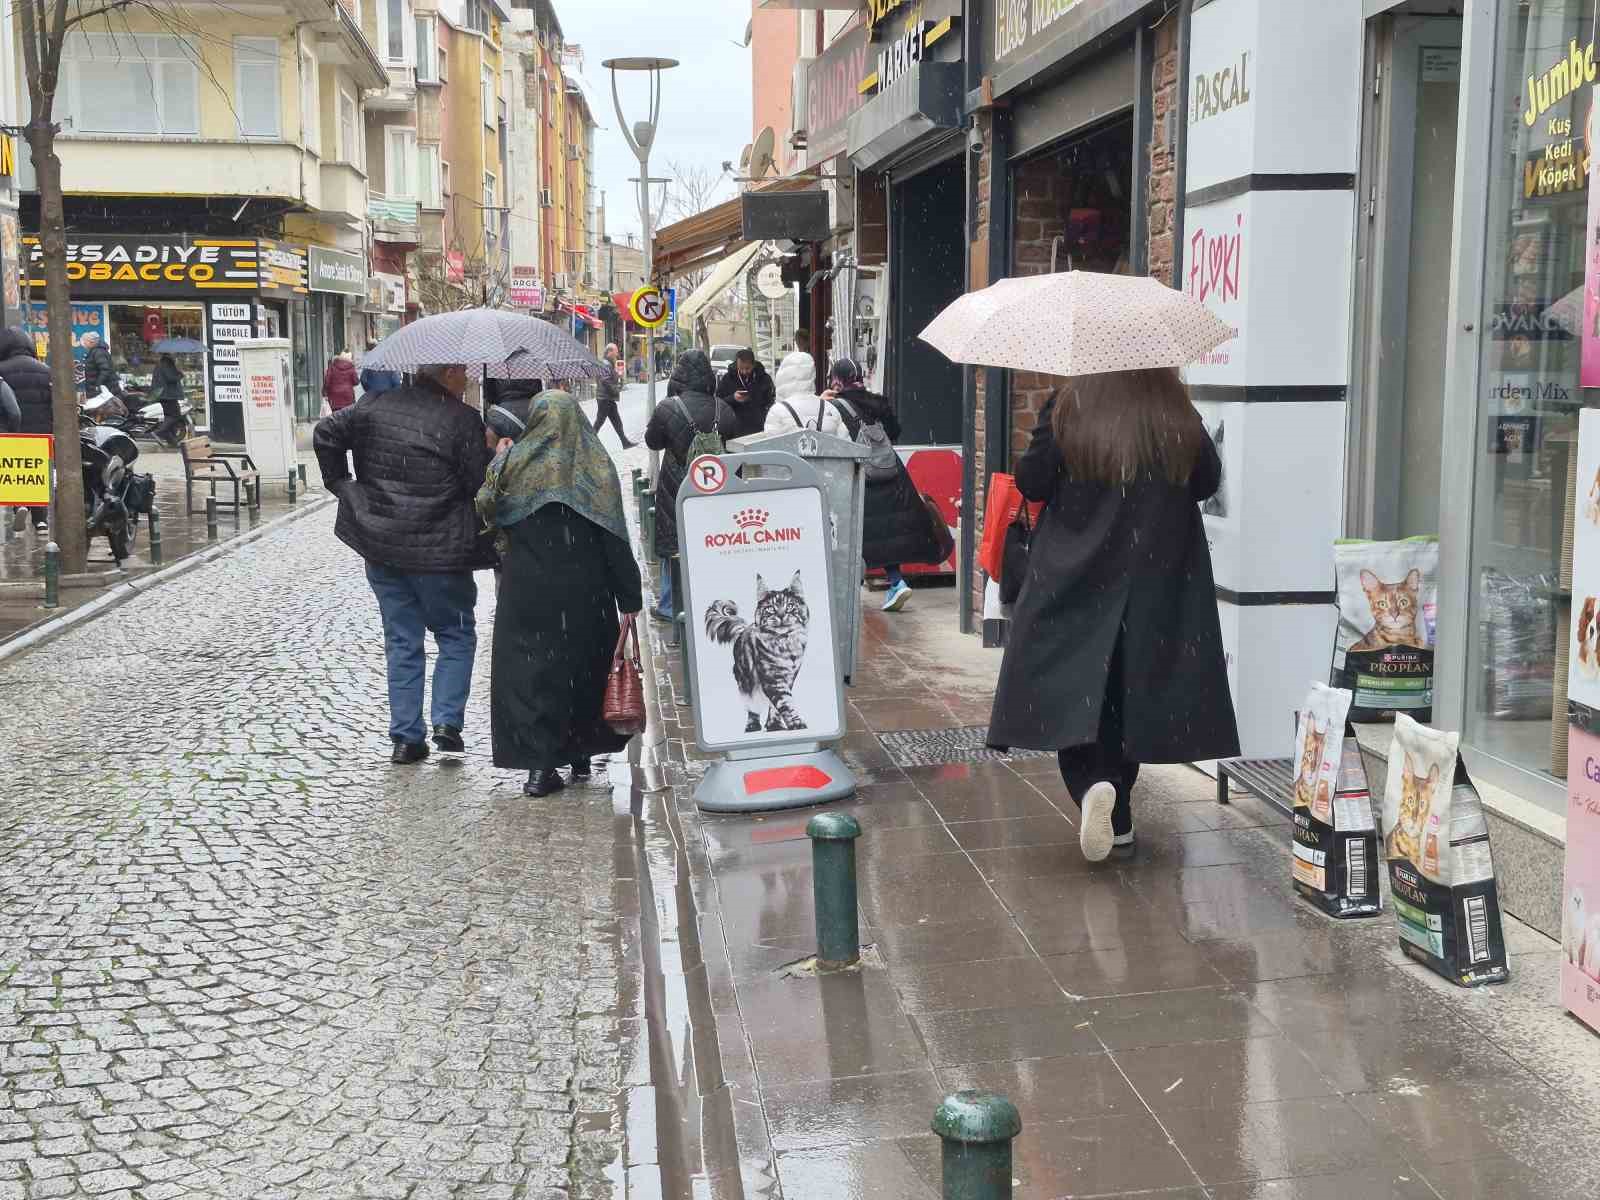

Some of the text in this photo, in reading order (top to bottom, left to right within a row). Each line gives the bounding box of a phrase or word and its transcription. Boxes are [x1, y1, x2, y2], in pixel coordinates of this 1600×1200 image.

[877, 20, 925, 94] MARKET
[1194, 51, 1250, 122] PASCAL
[1548, 118, 1571, 136] Kuş
[1545, 139, 1572, 161] Kedi
[1538, 162, 1576, 188] Köpek
[66, 262, 215, 281] OBACCO
[0, 457, 44, 469] NTEP
[705, 527, 801, 548] ROYAL CANIN
